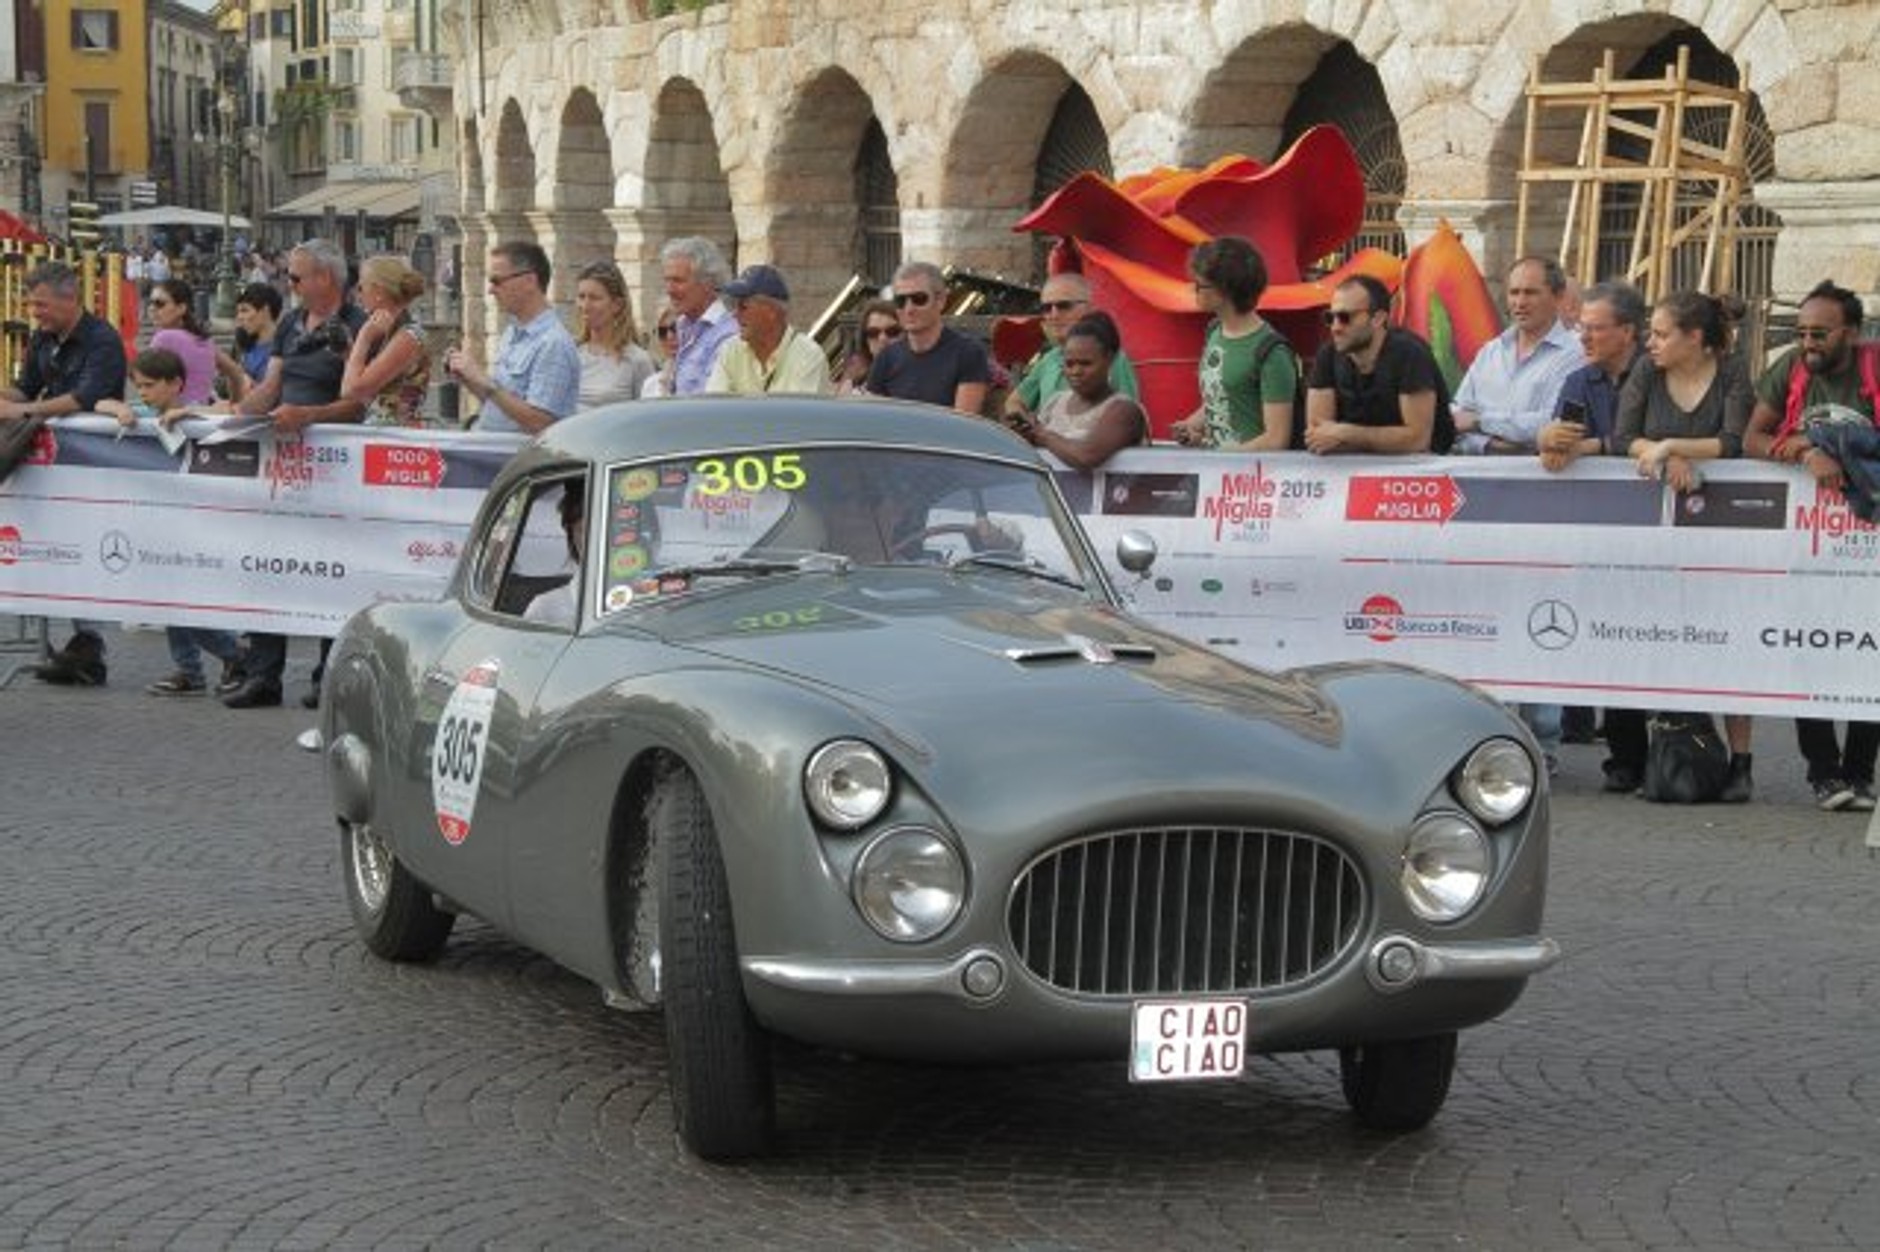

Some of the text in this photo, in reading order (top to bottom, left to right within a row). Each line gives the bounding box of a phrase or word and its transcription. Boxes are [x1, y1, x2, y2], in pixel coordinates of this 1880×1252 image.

[317, 446, 348, 462] 2015
[695, 454, 806, 495] 305
[1222, 459, 1325, 498] Mille 2015
[1382, 481, 1440, 497] 1000
[1203, 495, 1273, 541] Miglia
[241, 556, 345, 578] CHOPARD
[1590, 622, 1730, 645] Mercedes-Benz
[437, 717, 483, 785] 305
[1160, 1005, 1241, 1038] CIAO
[1157, 1041, 1239, 1074] CIAO
